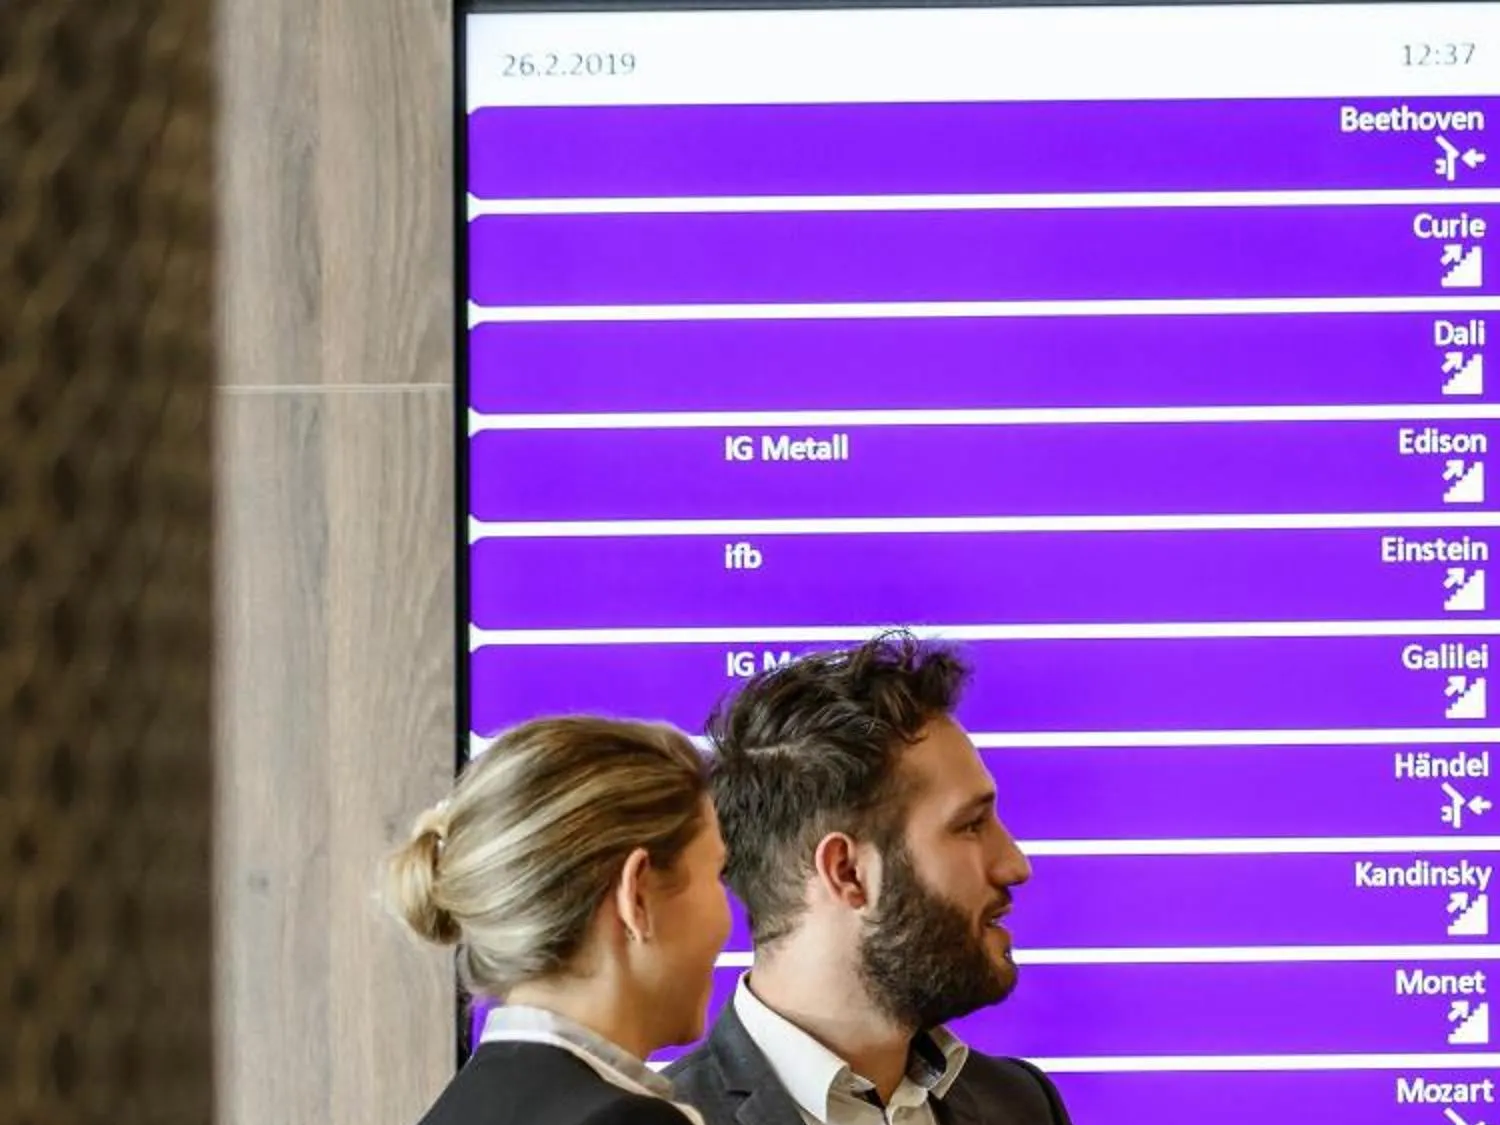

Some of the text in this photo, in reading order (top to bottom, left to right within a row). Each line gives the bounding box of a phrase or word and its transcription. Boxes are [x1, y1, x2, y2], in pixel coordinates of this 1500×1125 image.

[502, 53, 636, 76] 26.2.2019
[1402, 43, 1476, 66] 12:37
[1340, 105, 1485, 132] Beethoven
[1413, 212, 1487, 239] Curie
[1434, 319, 1486, 346] Dali
[725, 433, 849, 461] IG Metall
[1399, 427, 1487, 455] Edison
[725, 542, 763, 569] ifb
[1381, 535, 1489, 563] Einstein
[726, 651, 755, 677] IG
[1401, 642, 1489, 670] Galilei
[1394, 751, 1489, 779] Händel
[1355, 859, 1493, 889] Kandinsky
[1395, 969, 1486, 995] Monet
[1396, 1077, 1495, 1104] Mozart
